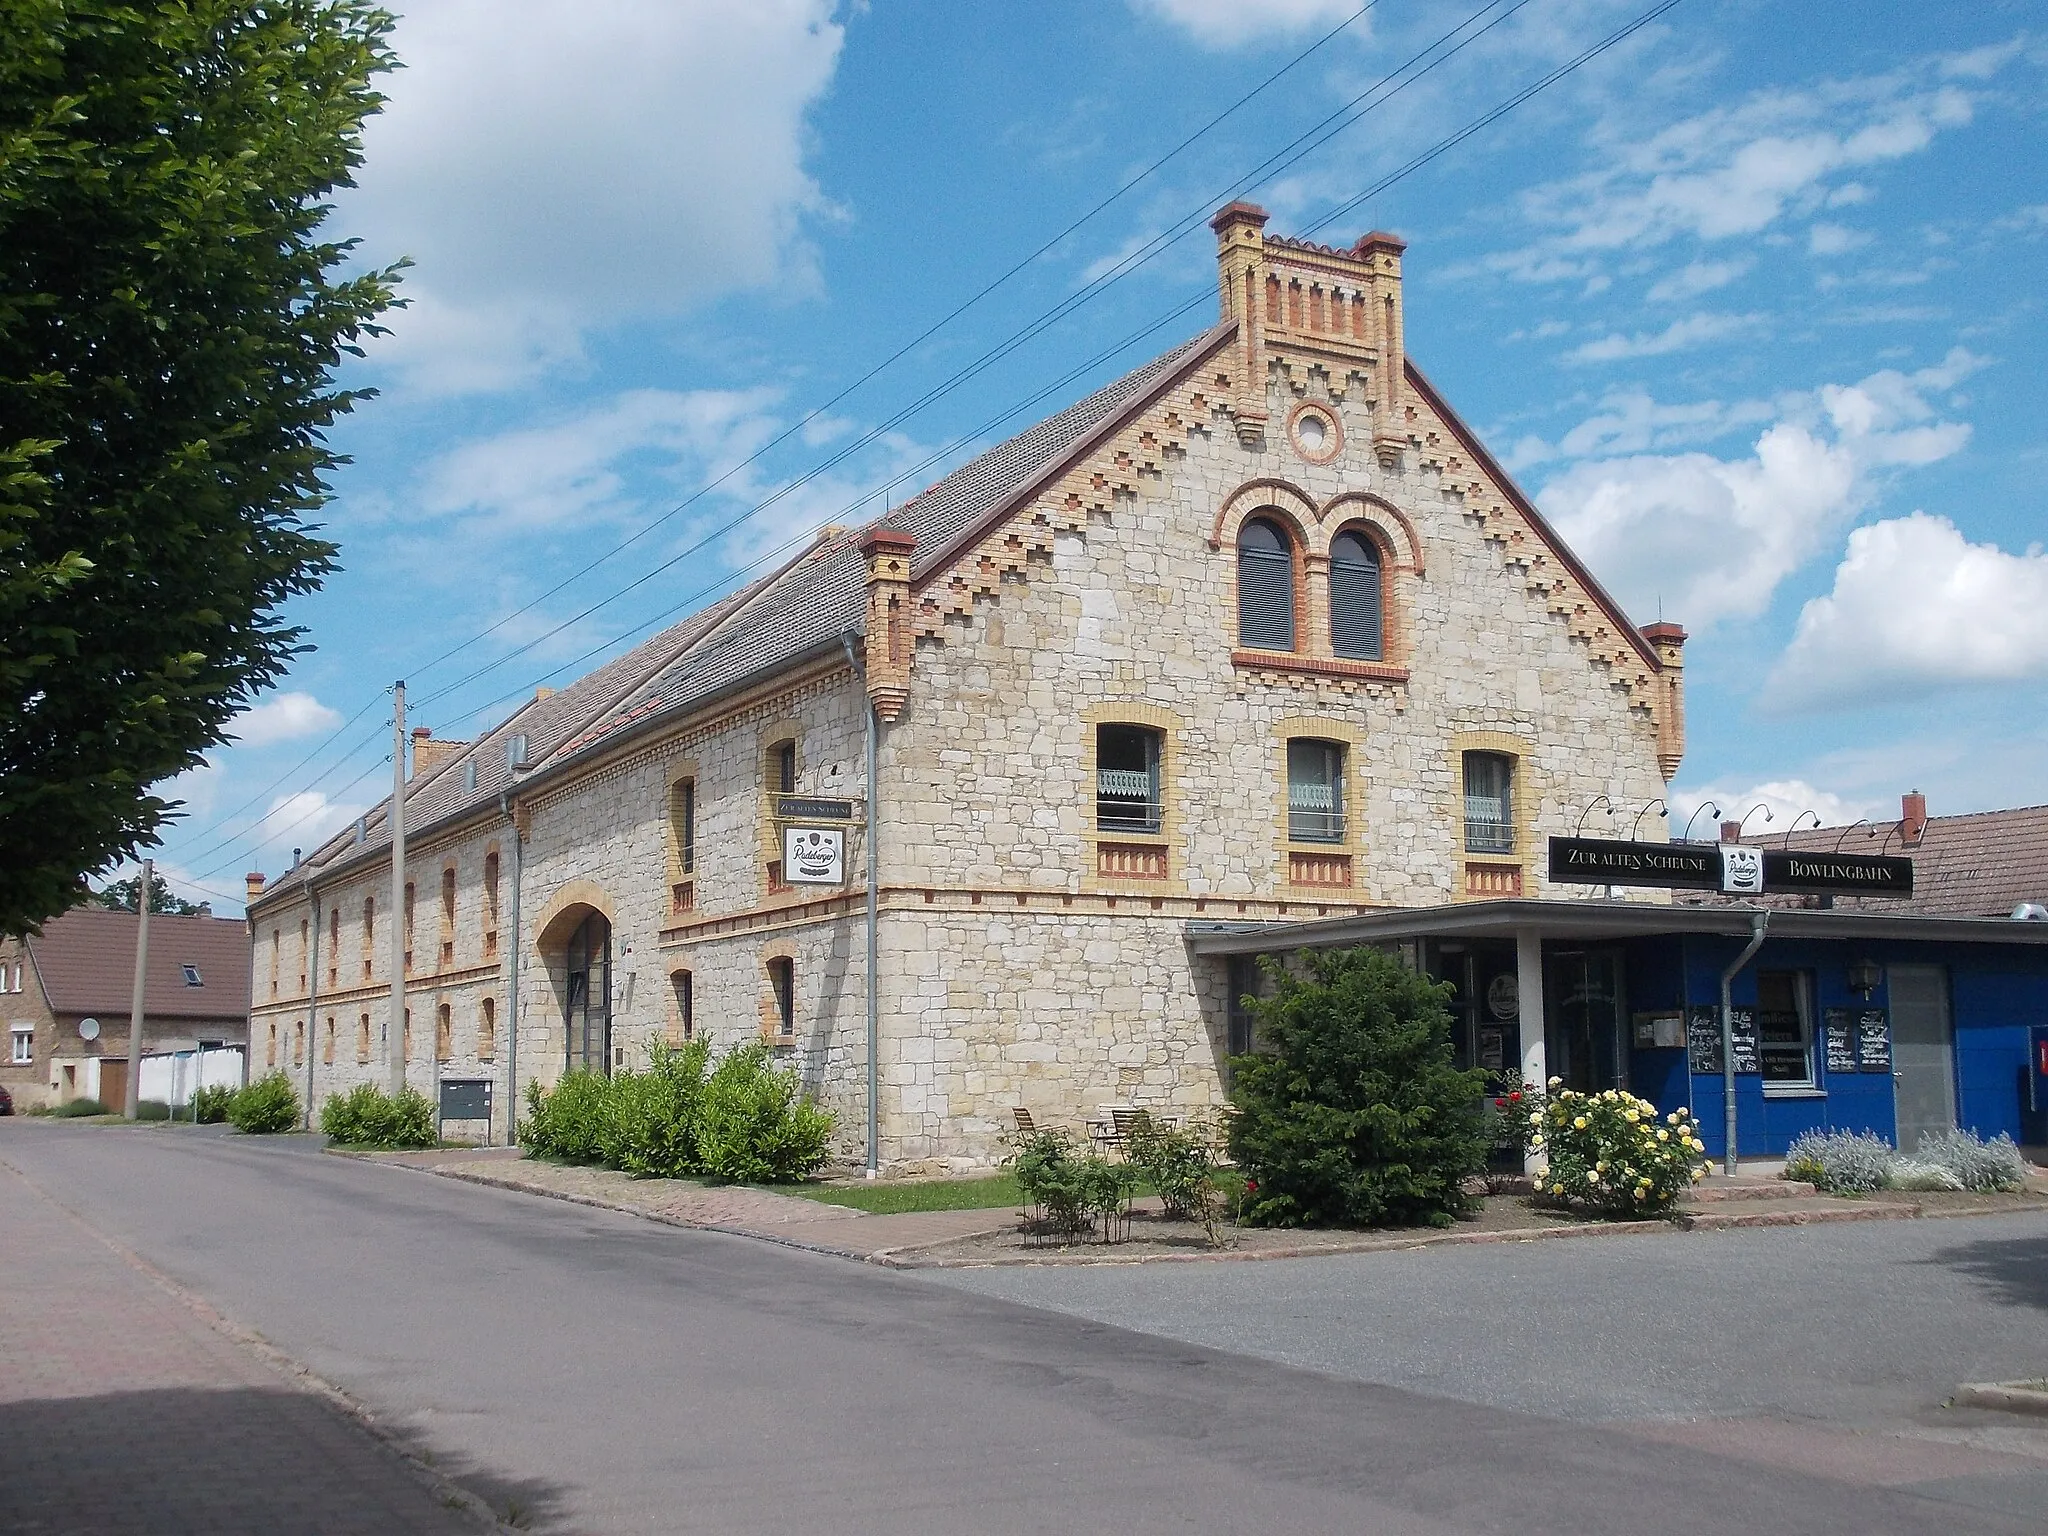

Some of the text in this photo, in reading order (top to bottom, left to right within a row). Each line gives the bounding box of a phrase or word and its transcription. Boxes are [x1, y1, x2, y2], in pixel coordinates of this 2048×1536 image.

[793, 844, 834, 864] Radeberger
[1568, 848, 1706, 871] ZUR ALTEN SCHEUNE
[1789, 859, 1892, 880] BOWLINGBAHN
